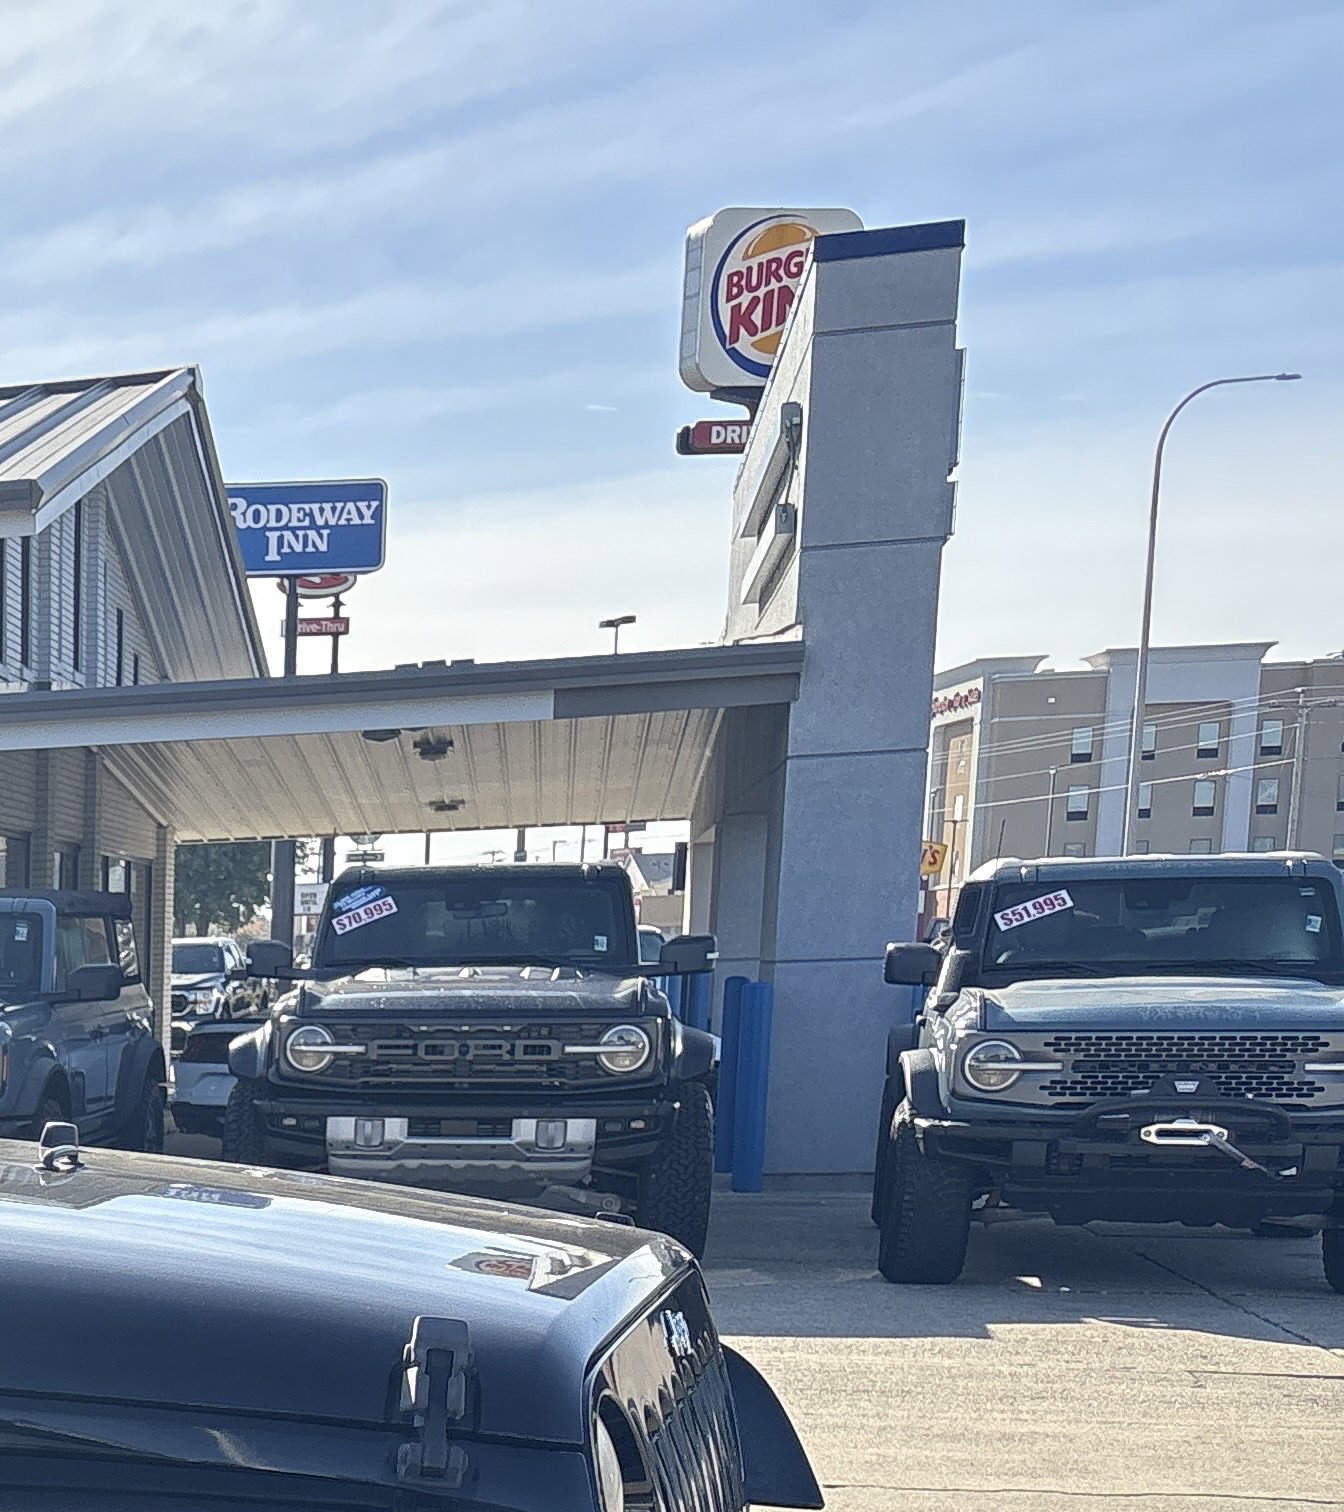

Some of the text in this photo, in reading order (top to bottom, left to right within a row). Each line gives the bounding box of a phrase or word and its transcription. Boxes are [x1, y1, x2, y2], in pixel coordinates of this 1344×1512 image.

[725, 248, 810, 304] BURG
[711, 425, 752, 444] DRI
[227, 497, 380, 529] RODEWAY
[265, 529, 331, 561] INN
[297, 620, 346, 633] rive-Thru
[367, 1039, 562, 1061] FORD
